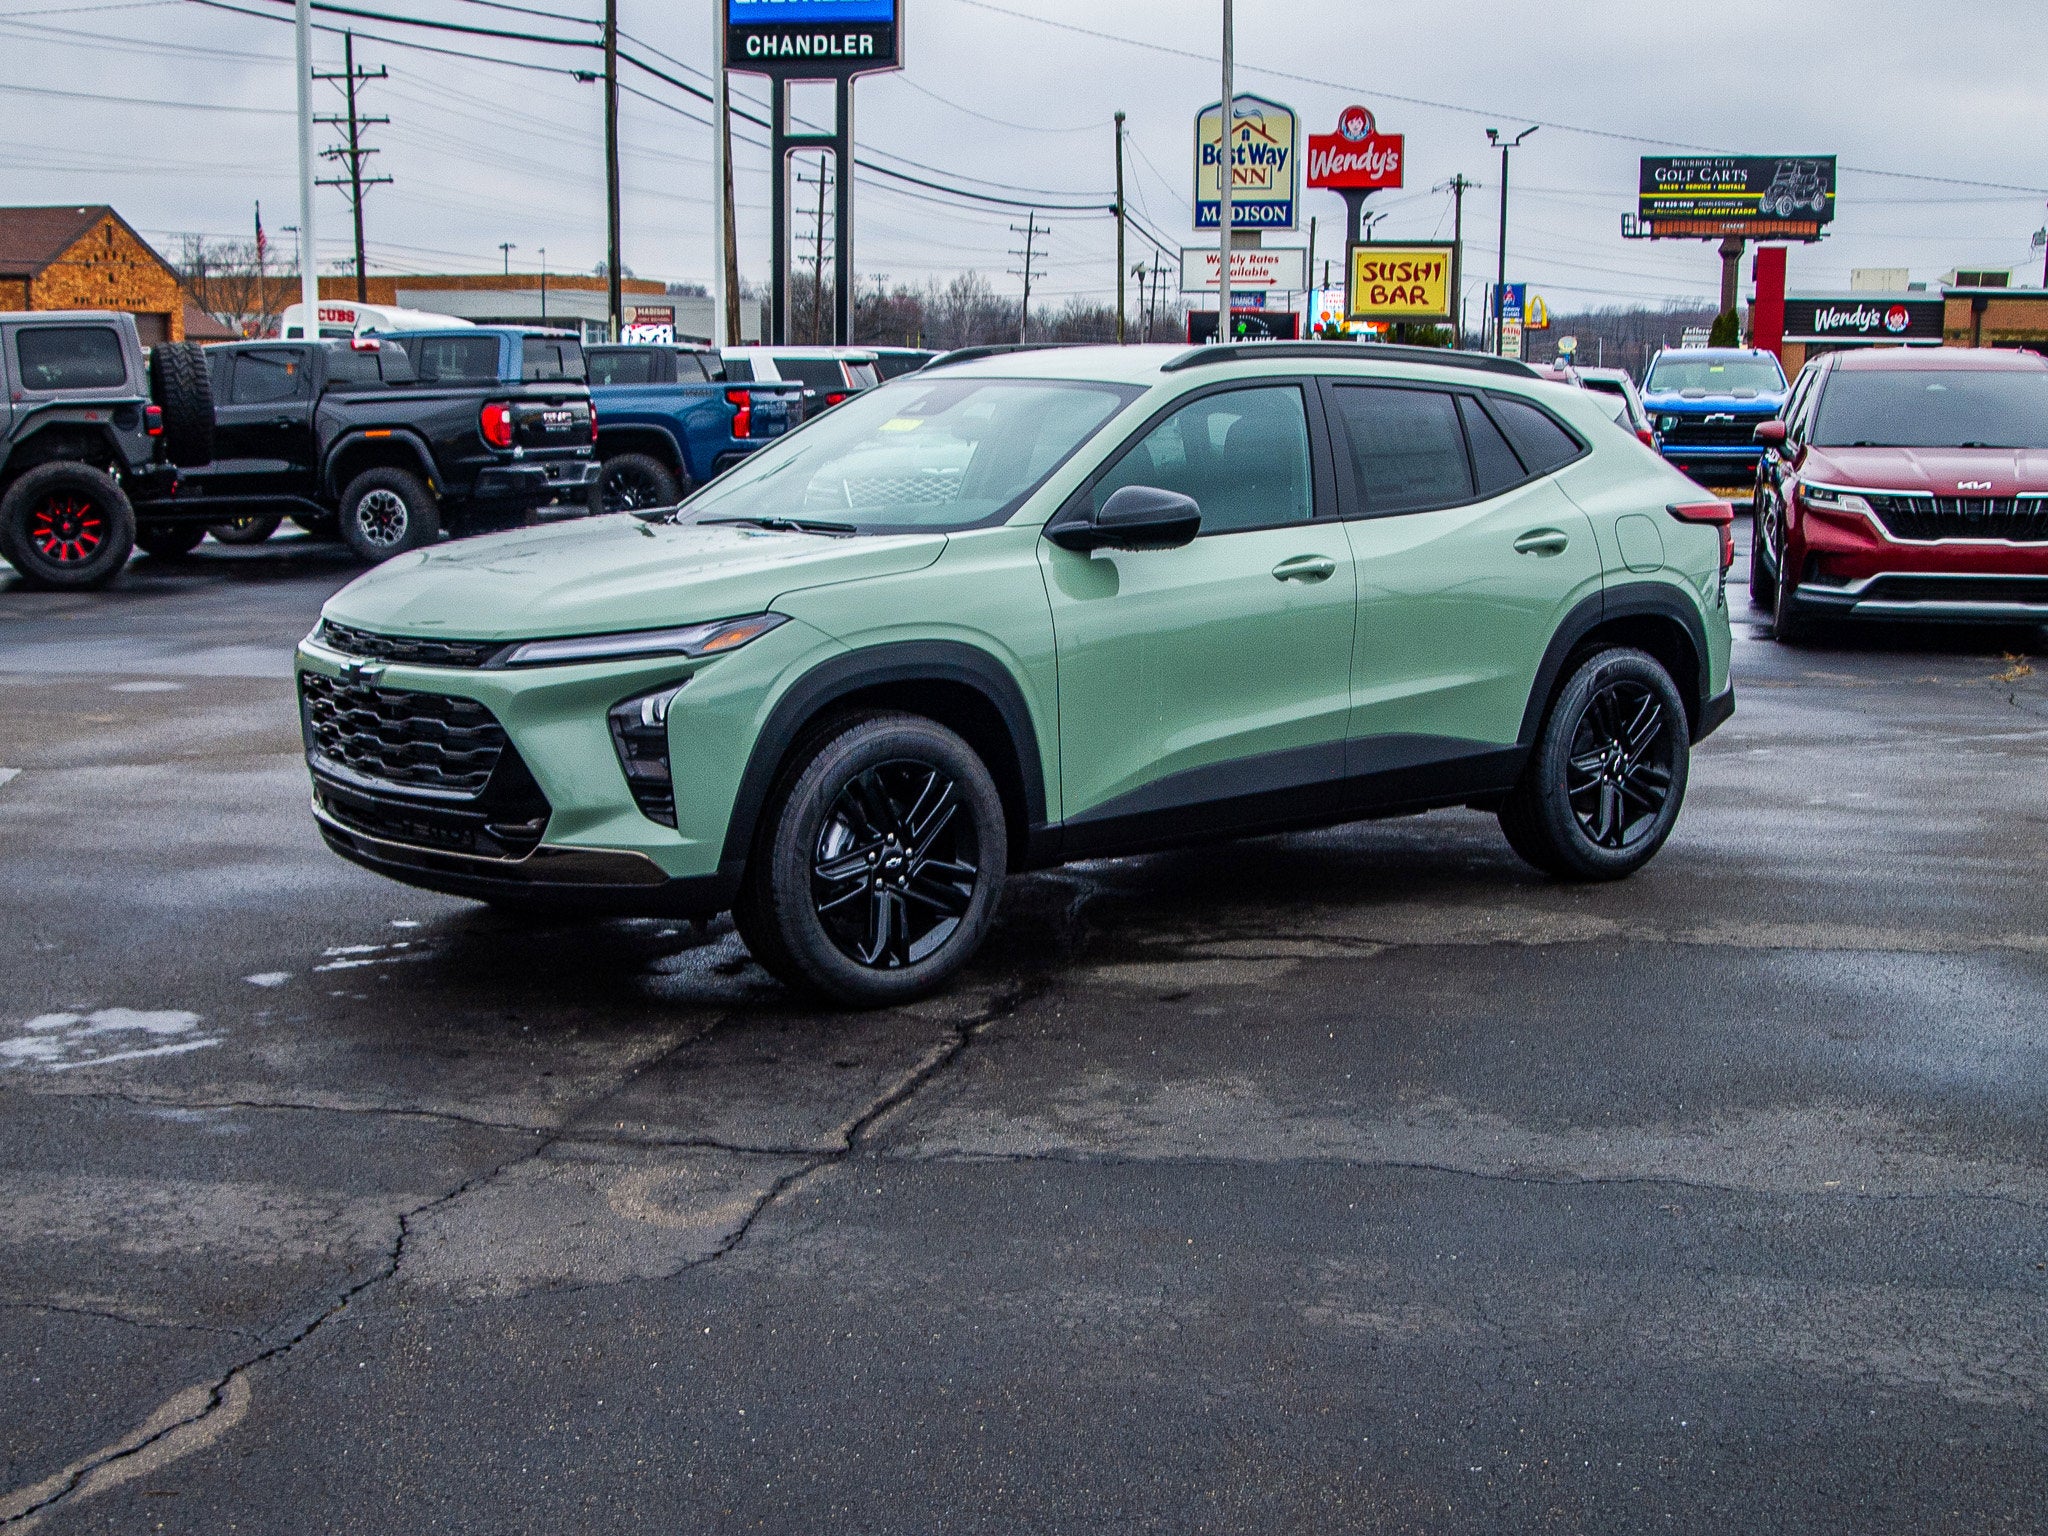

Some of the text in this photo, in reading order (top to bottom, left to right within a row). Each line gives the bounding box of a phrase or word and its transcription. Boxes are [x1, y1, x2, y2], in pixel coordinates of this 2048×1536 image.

[746, 34, 873, 56] CHANDLER
[1247, 143, 1289, 172] Way
[1310, 142, 1399, 180] Wendy's
[1715, 158, 1735, 167] CITY
[1231, 167, 1267, 185] NN
[1654, 167, 1748, 182] GOLF CARTS
[1201, 206, 1287, 222] MDISON
[1206, 254, 1279, 266] Wekly Rates
[1215, 267, 1269, 277] Aailable
[1362, 262, 1441, 282] SUSHI
[1370, 284, 1429, 305] BAR
[318, 308, 355, 322] CUBS
[1815, 304, 1880, 332] Wendy's
